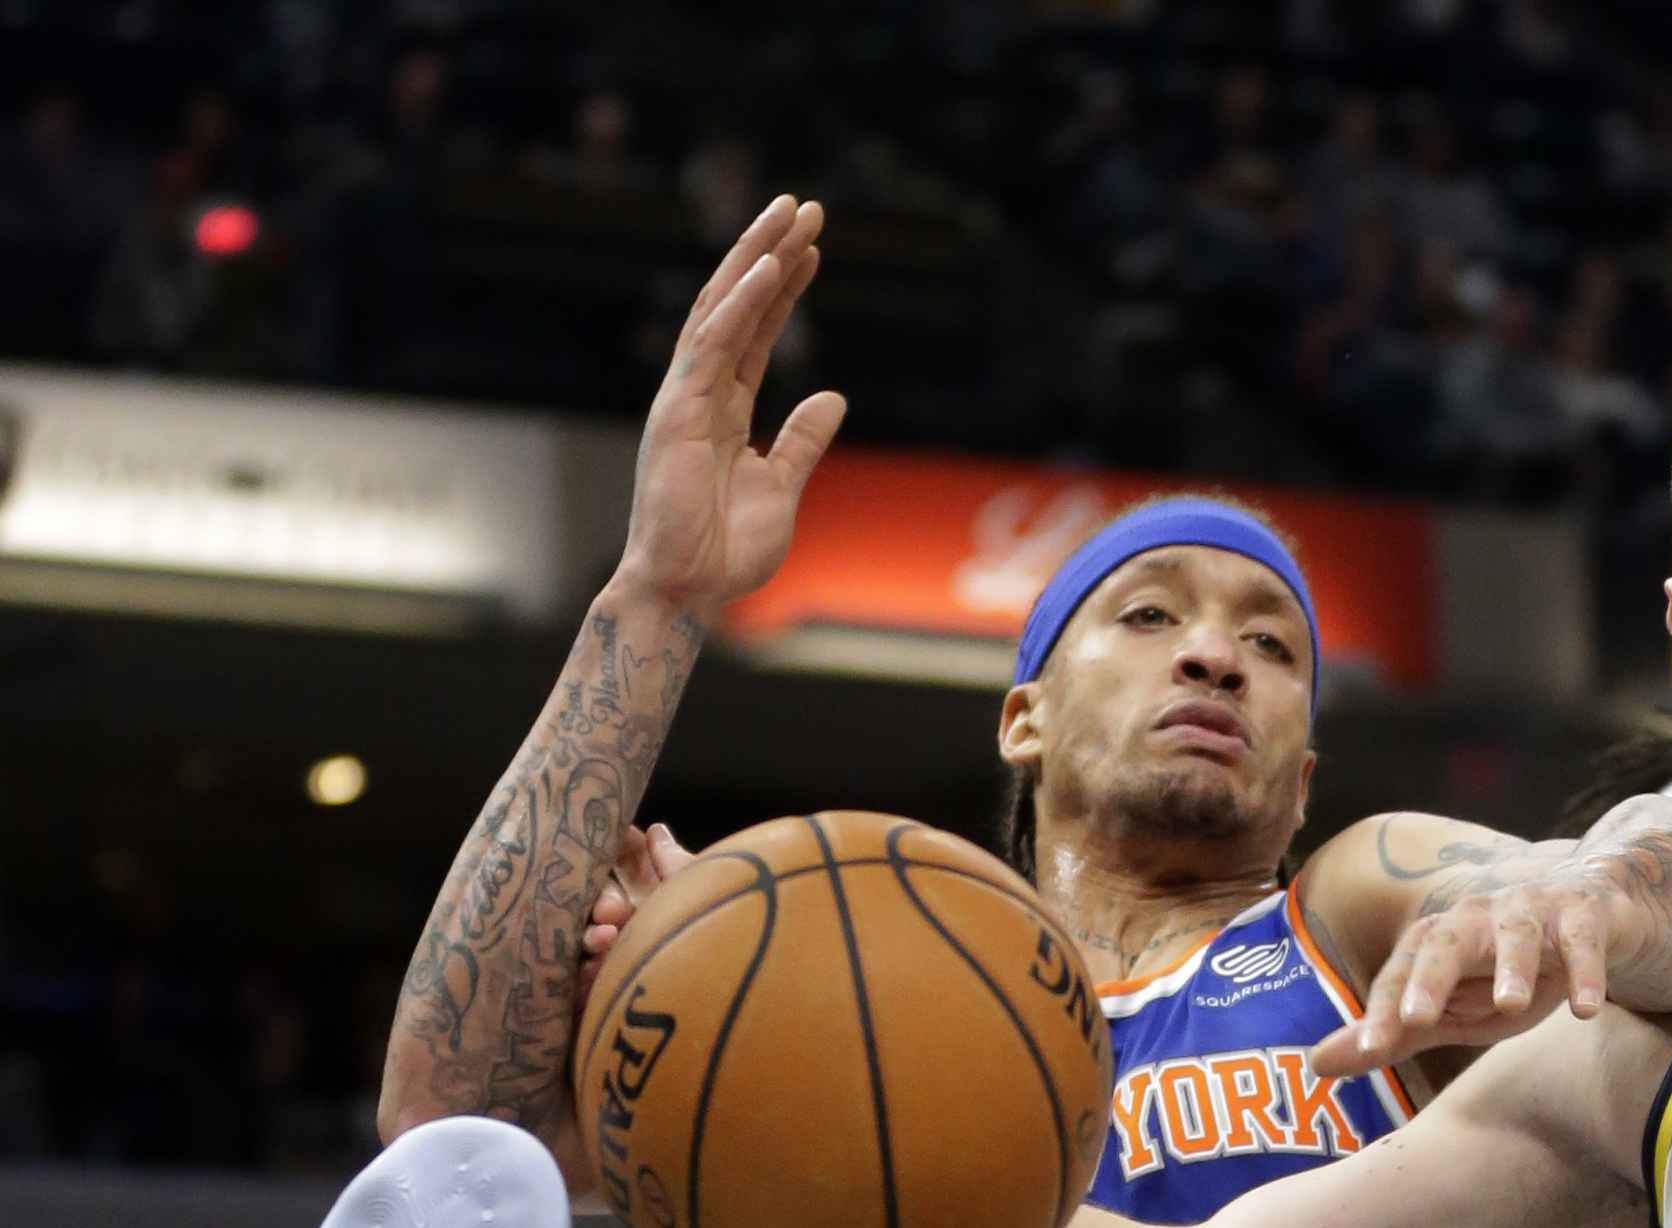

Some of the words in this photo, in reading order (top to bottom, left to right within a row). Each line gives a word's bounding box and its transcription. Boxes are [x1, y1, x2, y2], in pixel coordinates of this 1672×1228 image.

[1195, 964, 1313, 1007] SQUARESPACE
[598, 983, 677, 1216] SPALD
[1112, 1046, 1363, 1182] YORK
